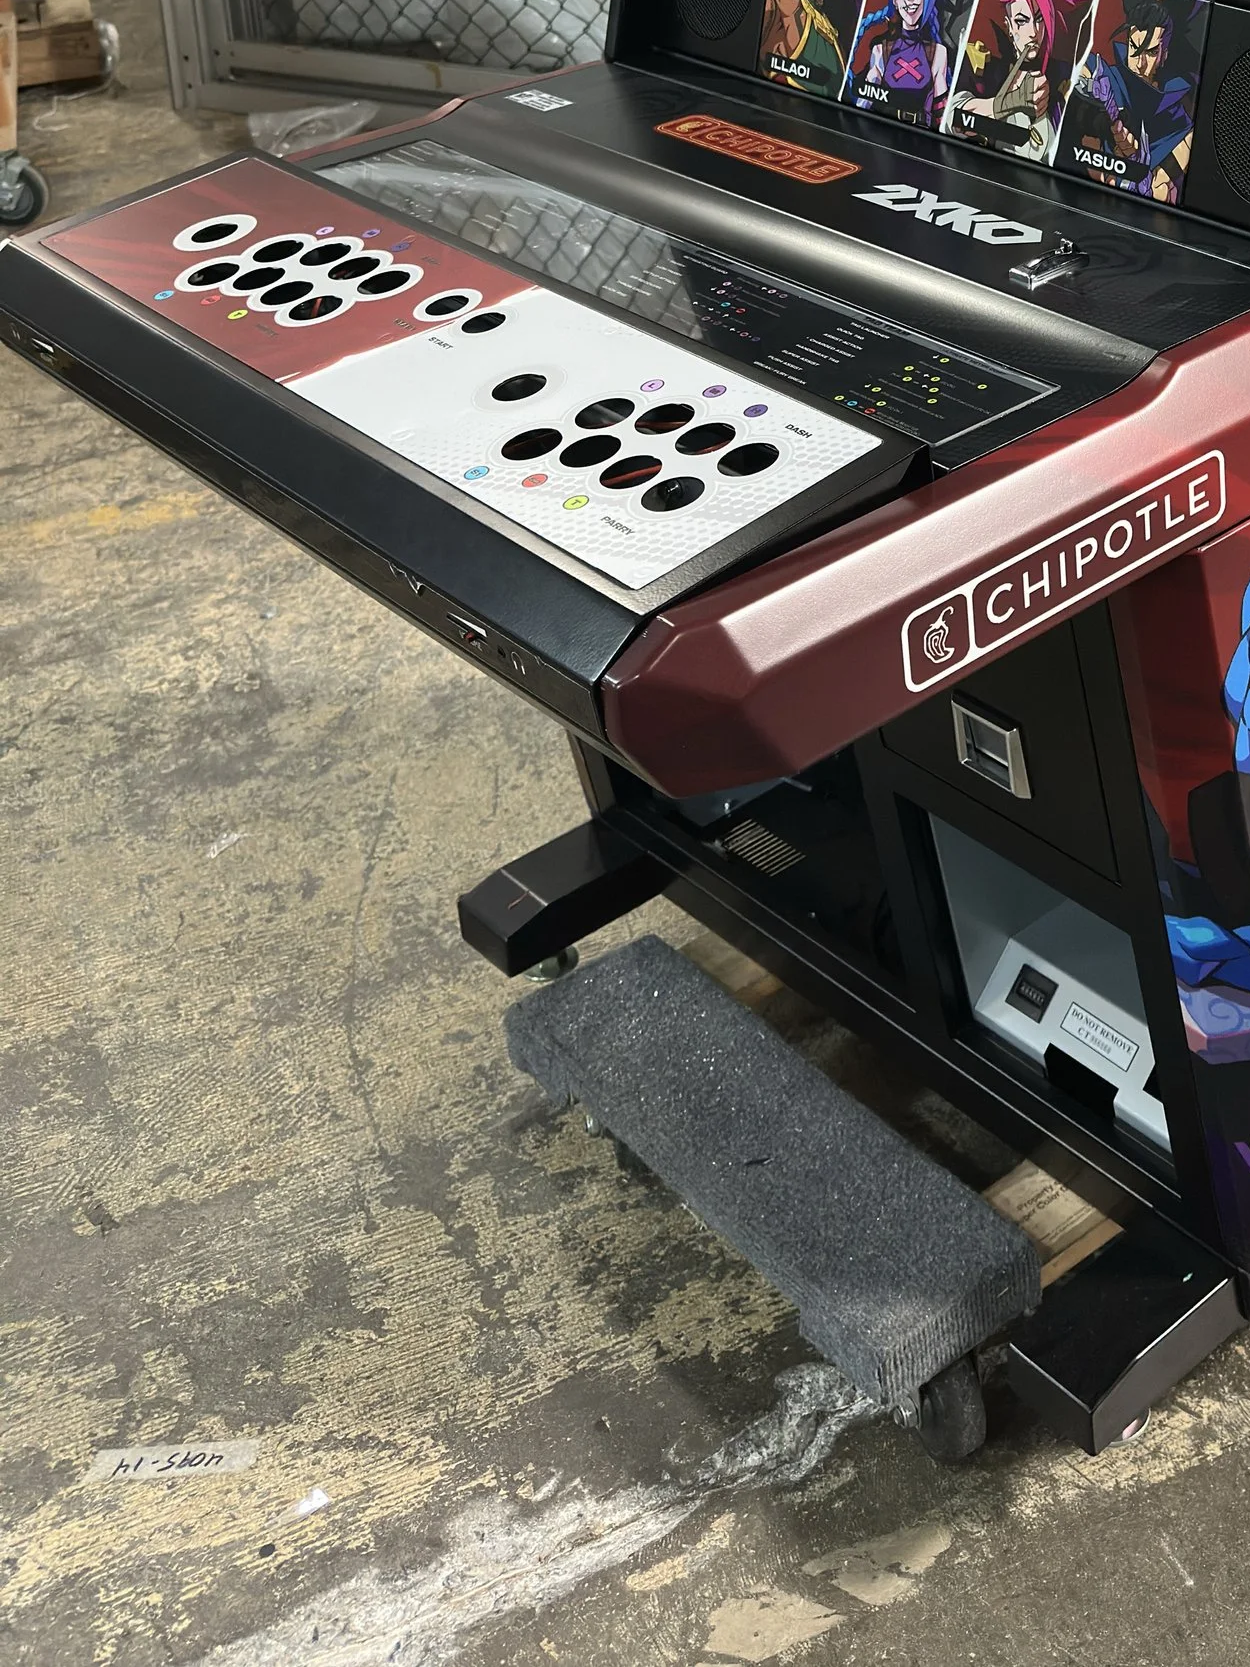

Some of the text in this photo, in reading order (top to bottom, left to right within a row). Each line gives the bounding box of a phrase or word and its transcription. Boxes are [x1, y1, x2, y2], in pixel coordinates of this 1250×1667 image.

[770, 57, 811, 79] ILLAOI
[858, 85, 889, 103] JINX
[961, 113, 975, 129] VI
[706, 129, 840, 177] CHIPOTLE
[1073, 147, 1127, 175] YASUO
[851, 184, 1043, 245] 2XKO
[428, 336, 454, 350] START
[785, 423, 812, 439] DASH
[600, 516, 635, 537] PARRY
[986, 473, 1211, 624] CHIPOTLE
[1071, 1008, 1084, 1022] DO
[1084, 1016, 1101, 1035] NOT
[1099, 1026, 1133, 1055] REMOVE
